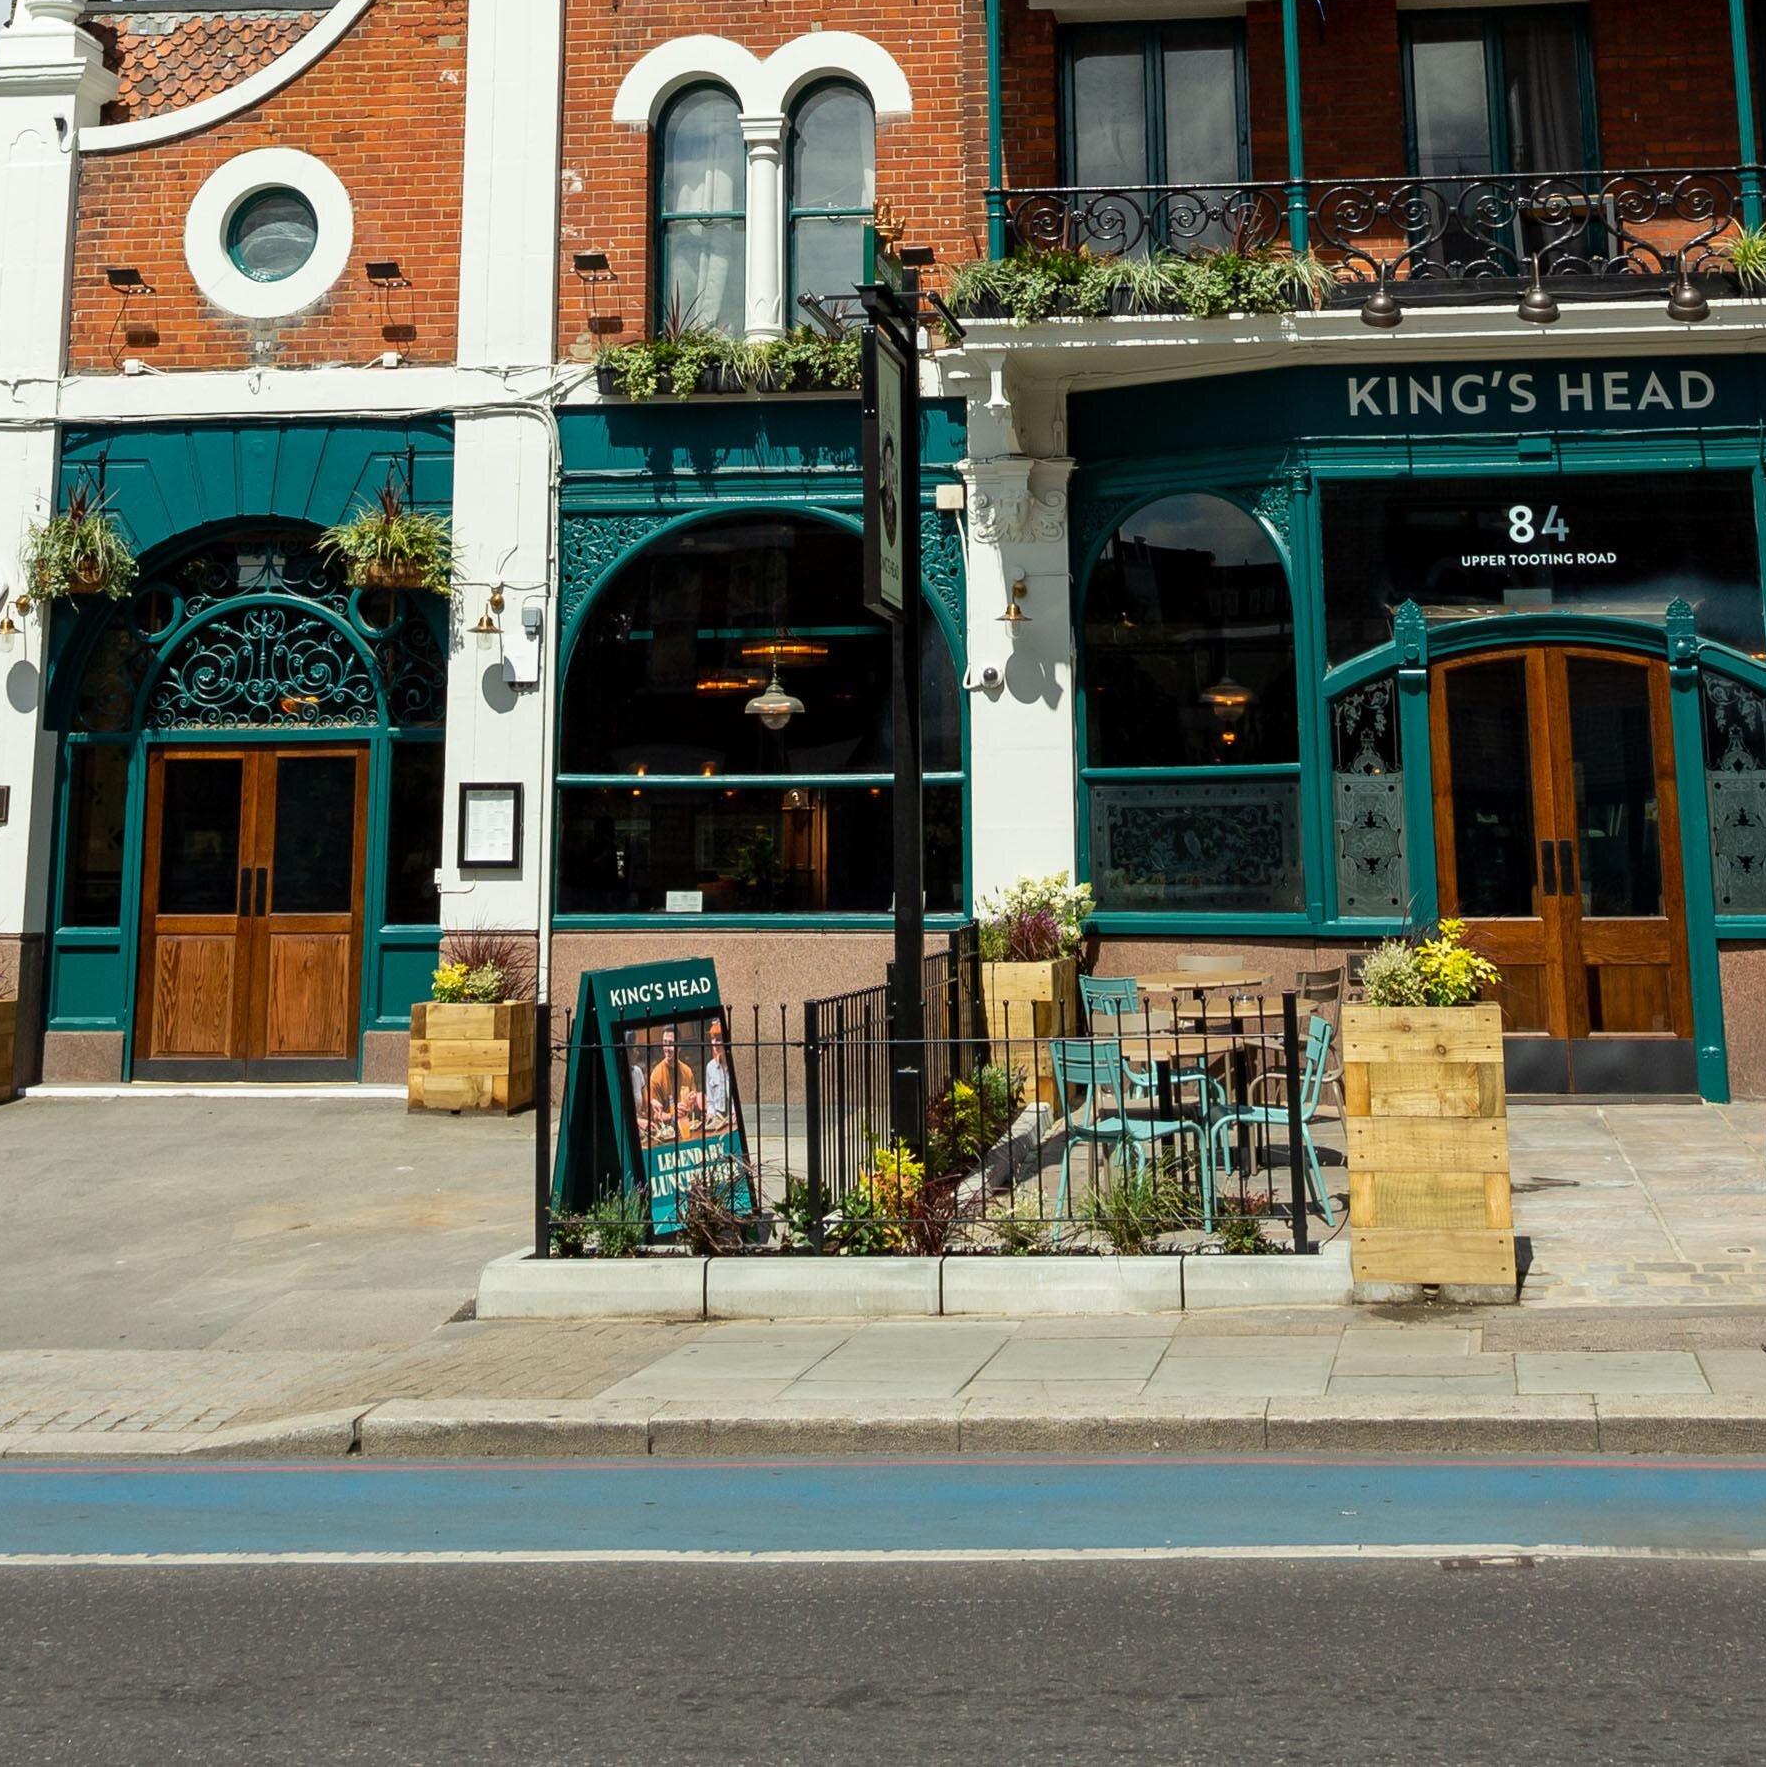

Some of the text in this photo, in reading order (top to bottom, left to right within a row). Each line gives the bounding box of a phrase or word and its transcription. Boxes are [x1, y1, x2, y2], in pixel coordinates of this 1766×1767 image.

[1347, 369, 1716, 417] KING'S HEAD
[1508, 504, 1570, 544] 84
[1461, 551, 1618, 568] UPPER TOOTING ROAD
[609, 977, 712, 1008] KING'S HEAD
